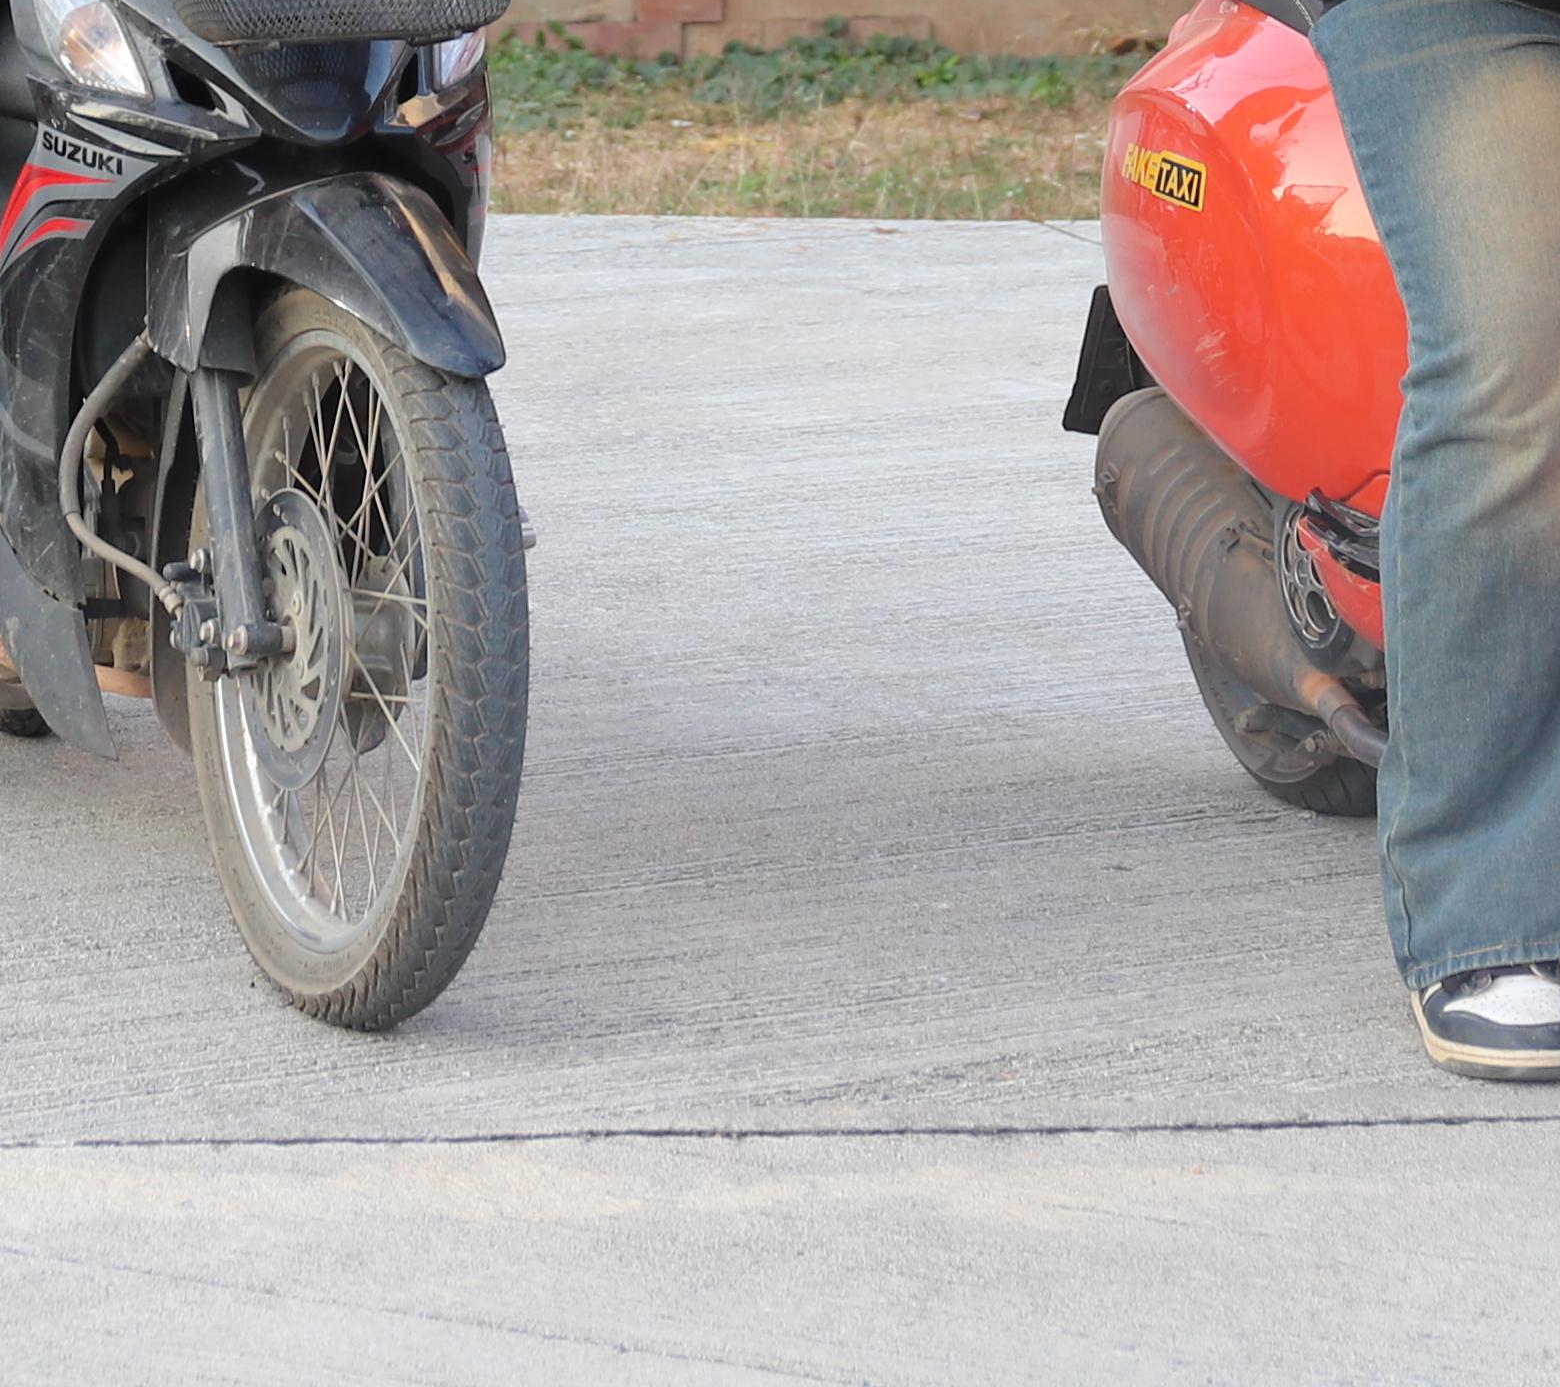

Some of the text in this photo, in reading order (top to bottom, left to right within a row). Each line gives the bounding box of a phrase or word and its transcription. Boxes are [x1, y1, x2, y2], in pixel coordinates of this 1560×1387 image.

[41, 130, 124, 176] SUZUKI
[1121, 142, 1199, 204] FAKE TAXI
